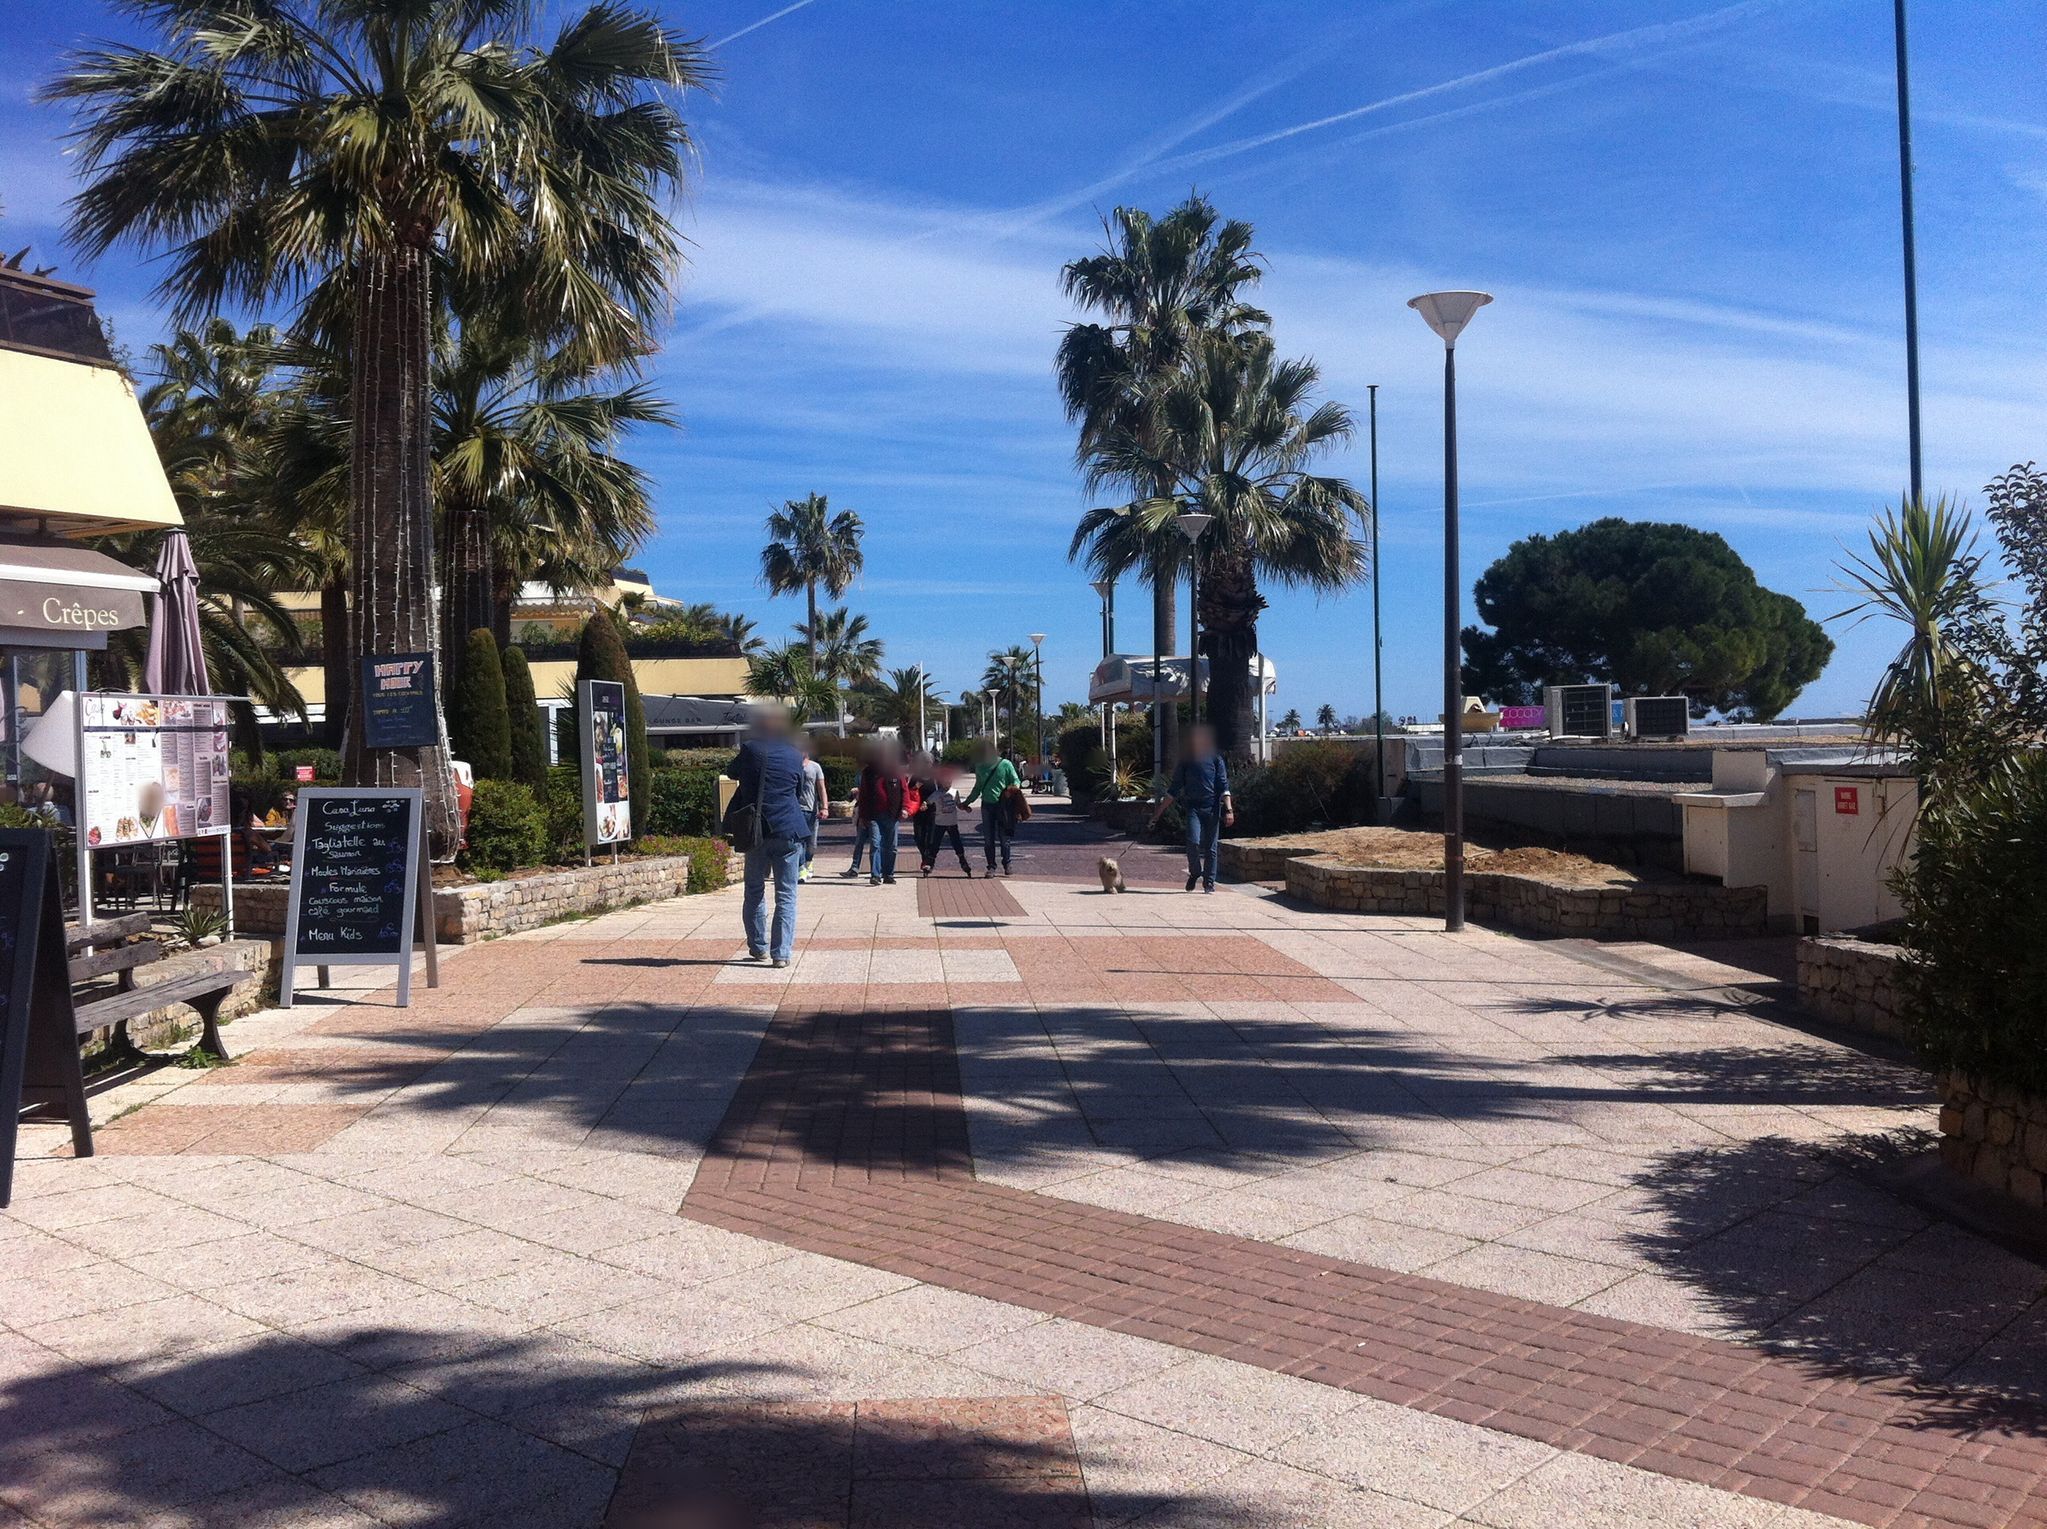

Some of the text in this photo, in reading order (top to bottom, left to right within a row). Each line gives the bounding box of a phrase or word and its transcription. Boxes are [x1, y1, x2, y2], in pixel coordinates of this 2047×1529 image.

[42, 597, 119, 630] Crêpes
[374, 661, 424, 677] HAPPY
[372, 838, 386, 847] au
